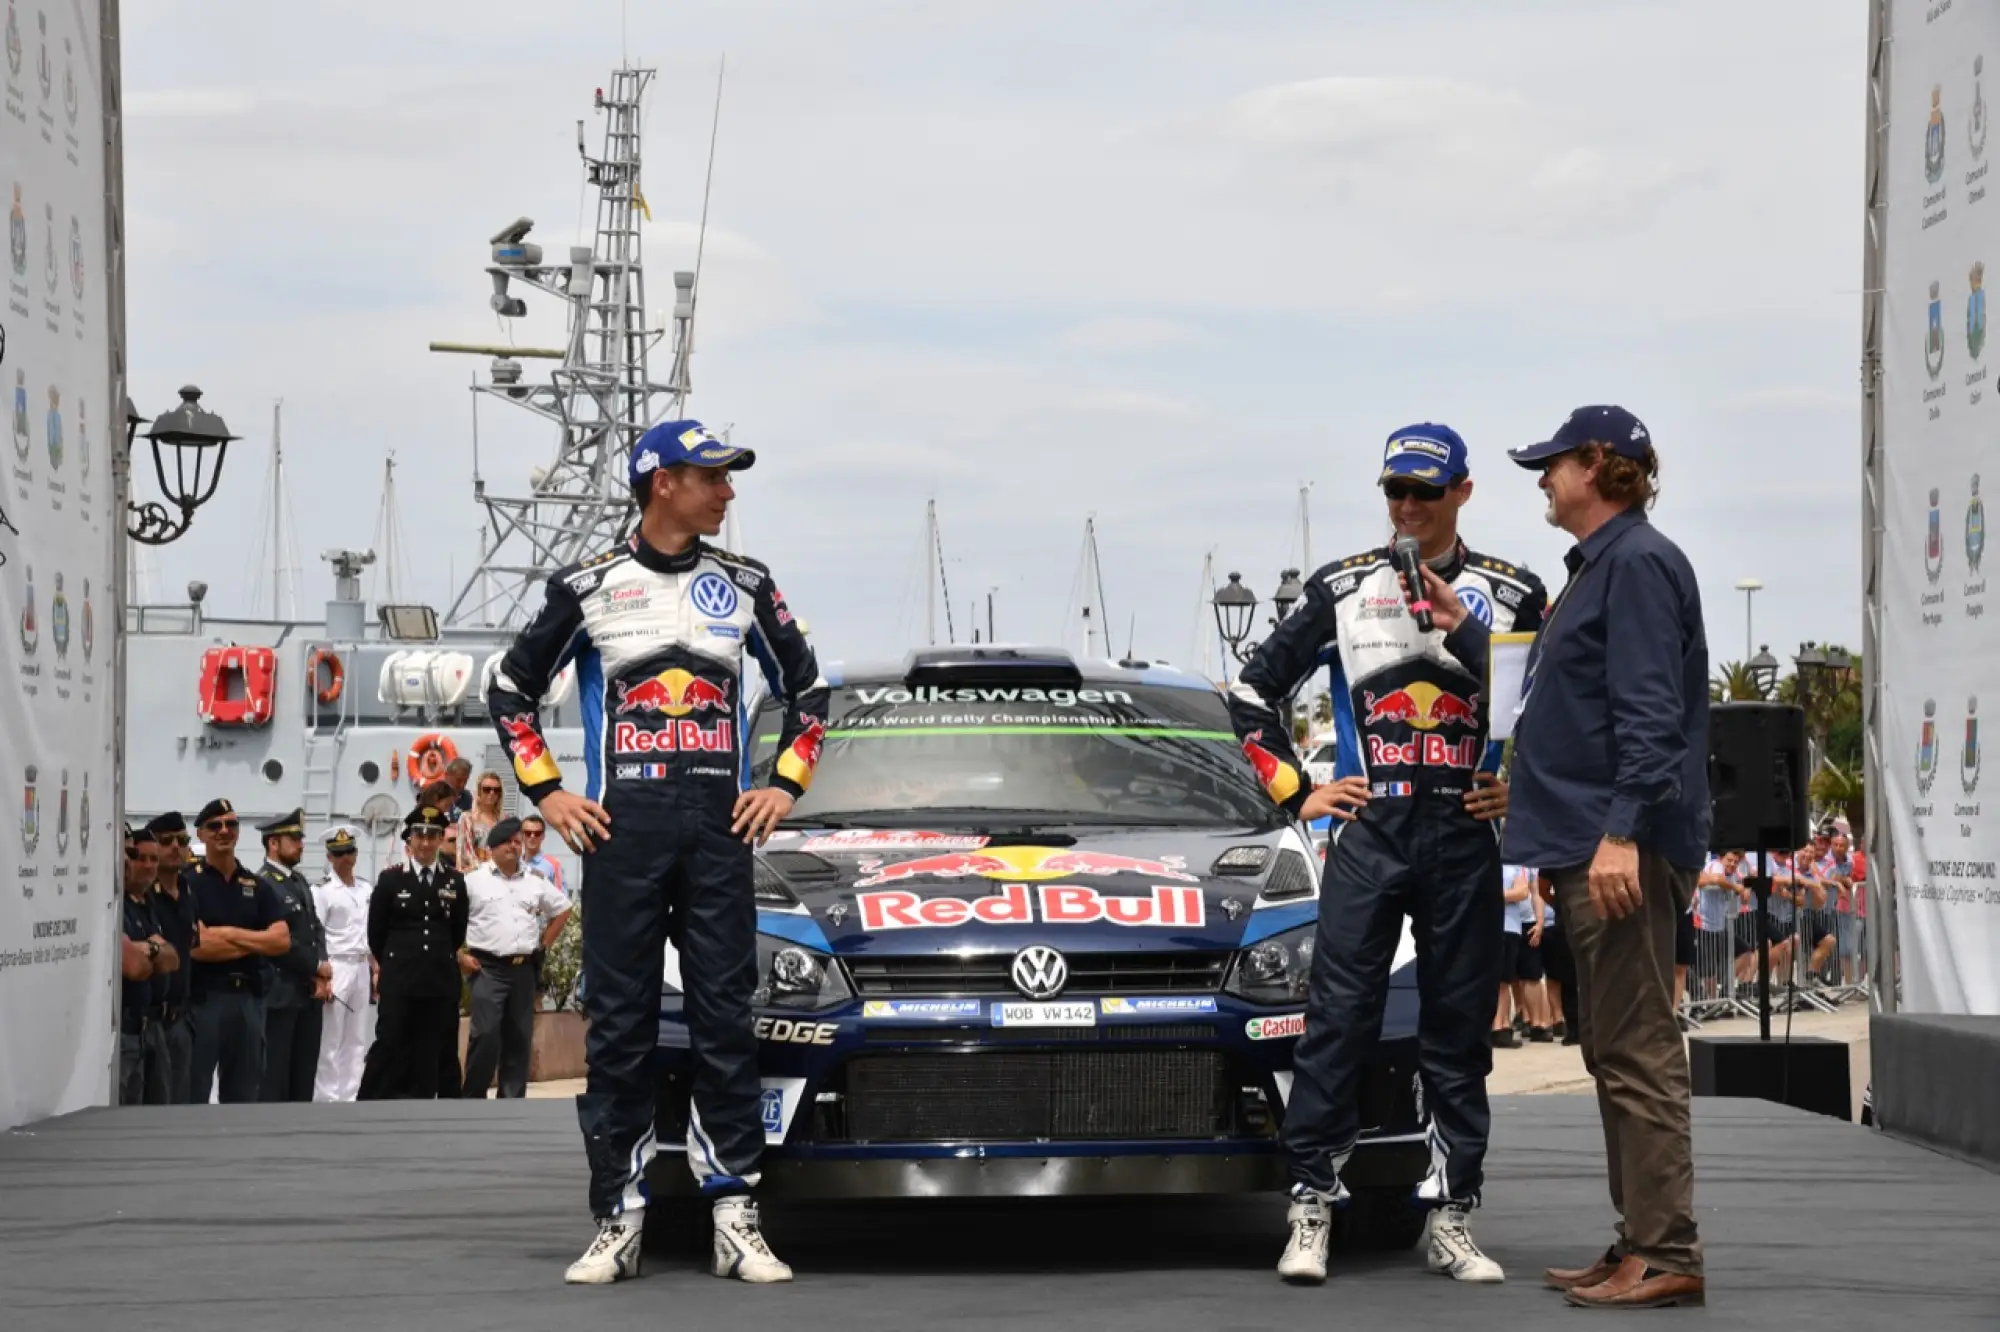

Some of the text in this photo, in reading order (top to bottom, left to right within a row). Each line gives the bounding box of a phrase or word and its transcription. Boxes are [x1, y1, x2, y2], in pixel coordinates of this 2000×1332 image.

[855, 686, 1134, 707] Volkswagen
[883, 715, 935, 725] World
[940, 713, 985, 725] Rally
[991, 712, 1117, 726] Championship
[615, 719, 732, 754] Red Bull
[1367, 731, 1476, 769] Red Bull
[856, 883, 1205, 931] Red Bull
[898, 1003, 977, 1013] MICHELIN
[1005, 1006, 1033, 1020] WOB
[1136, 1000, 1212, 1009] MICHELIN
[753, 1017, 840, 1045] EDGE
[1262, 1016, 1307, 1037] Castrol
